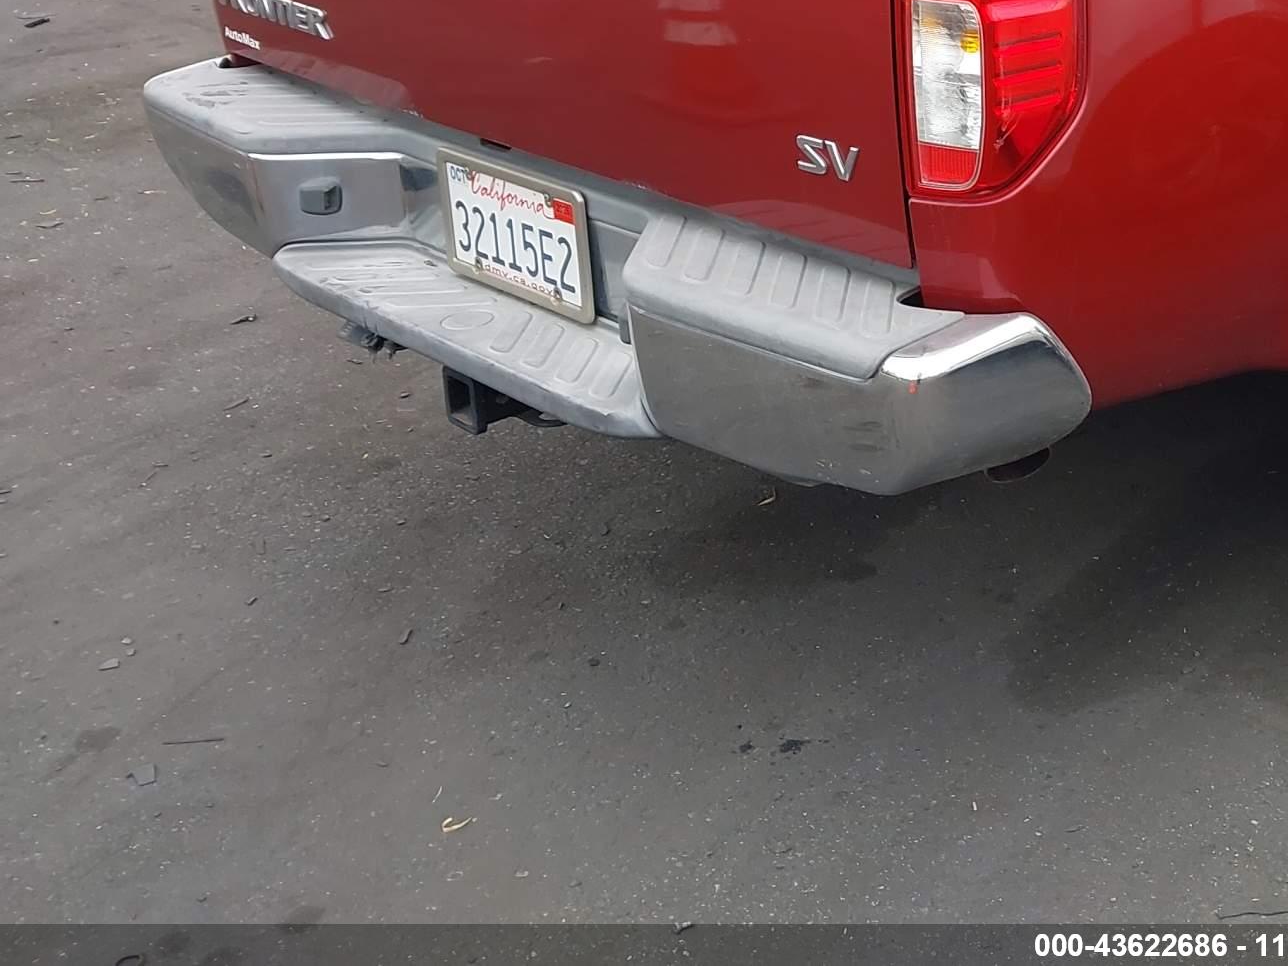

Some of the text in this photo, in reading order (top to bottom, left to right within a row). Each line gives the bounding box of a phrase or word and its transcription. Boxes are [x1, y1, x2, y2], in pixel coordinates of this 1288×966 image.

[225, 26, 260, 50] AutoMax
[450, 166, 467, 182] OCT
[796, 134, 859, 182] SV
[467, 170, 546, 215] California
[455, 200, 576, 294] 32115E2
[484, 264, 554, 299] dmv.ca.gov
